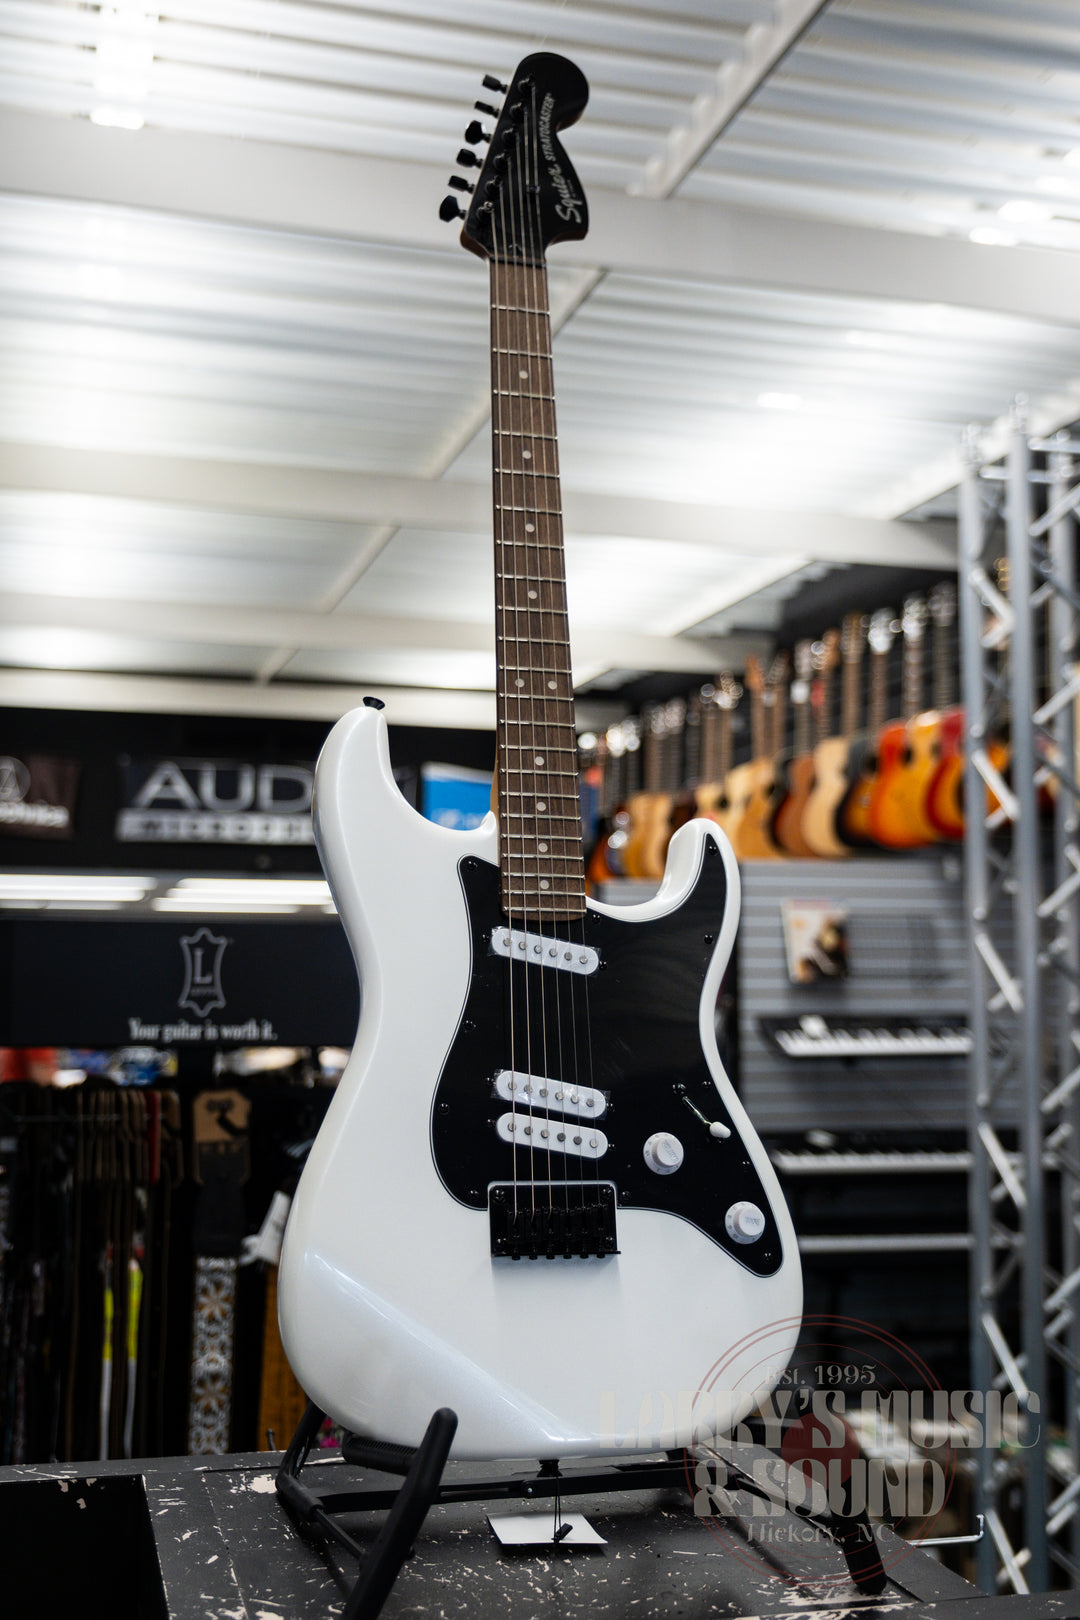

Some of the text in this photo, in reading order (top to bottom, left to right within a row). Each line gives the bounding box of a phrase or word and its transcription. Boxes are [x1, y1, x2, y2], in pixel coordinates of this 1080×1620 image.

[539, 93, 556, 161] STRATOCASTER
[548, 164, 583, 223] Squier
[129, 1017, 278, 1043] Your guitar is worth it.
